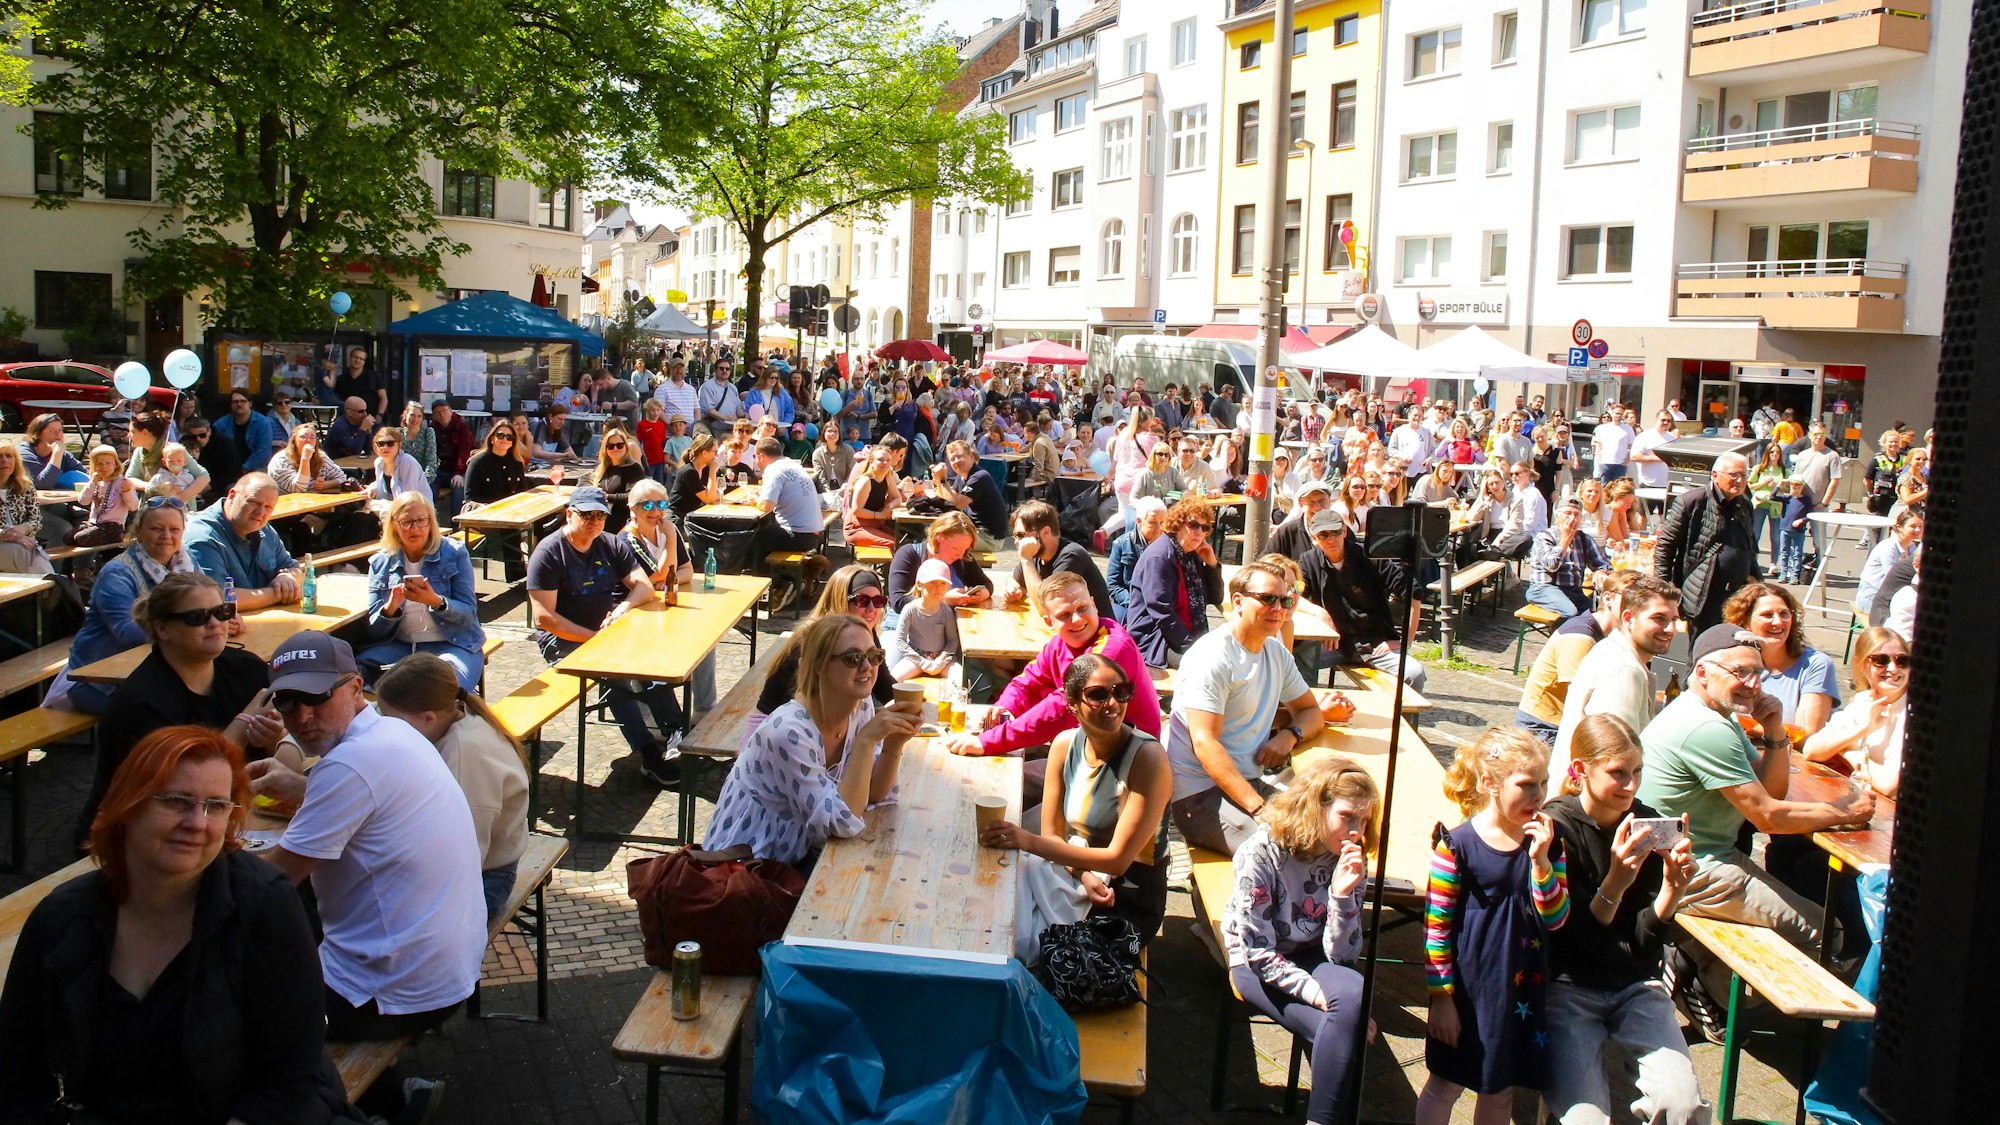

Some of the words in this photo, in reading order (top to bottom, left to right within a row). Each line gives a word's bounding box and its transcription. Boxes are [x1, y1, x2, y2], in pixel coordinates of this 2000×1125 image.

[1439, 303, 1471, 313] SPORT
[1473, 302, 1503, 313] BÜLLE
[1156, 310, 1164, 321] P
[1576, 326, 1589, 339] 30
[1571, 350, 1583, 365] P
[273, 649, 317, 668] mares
